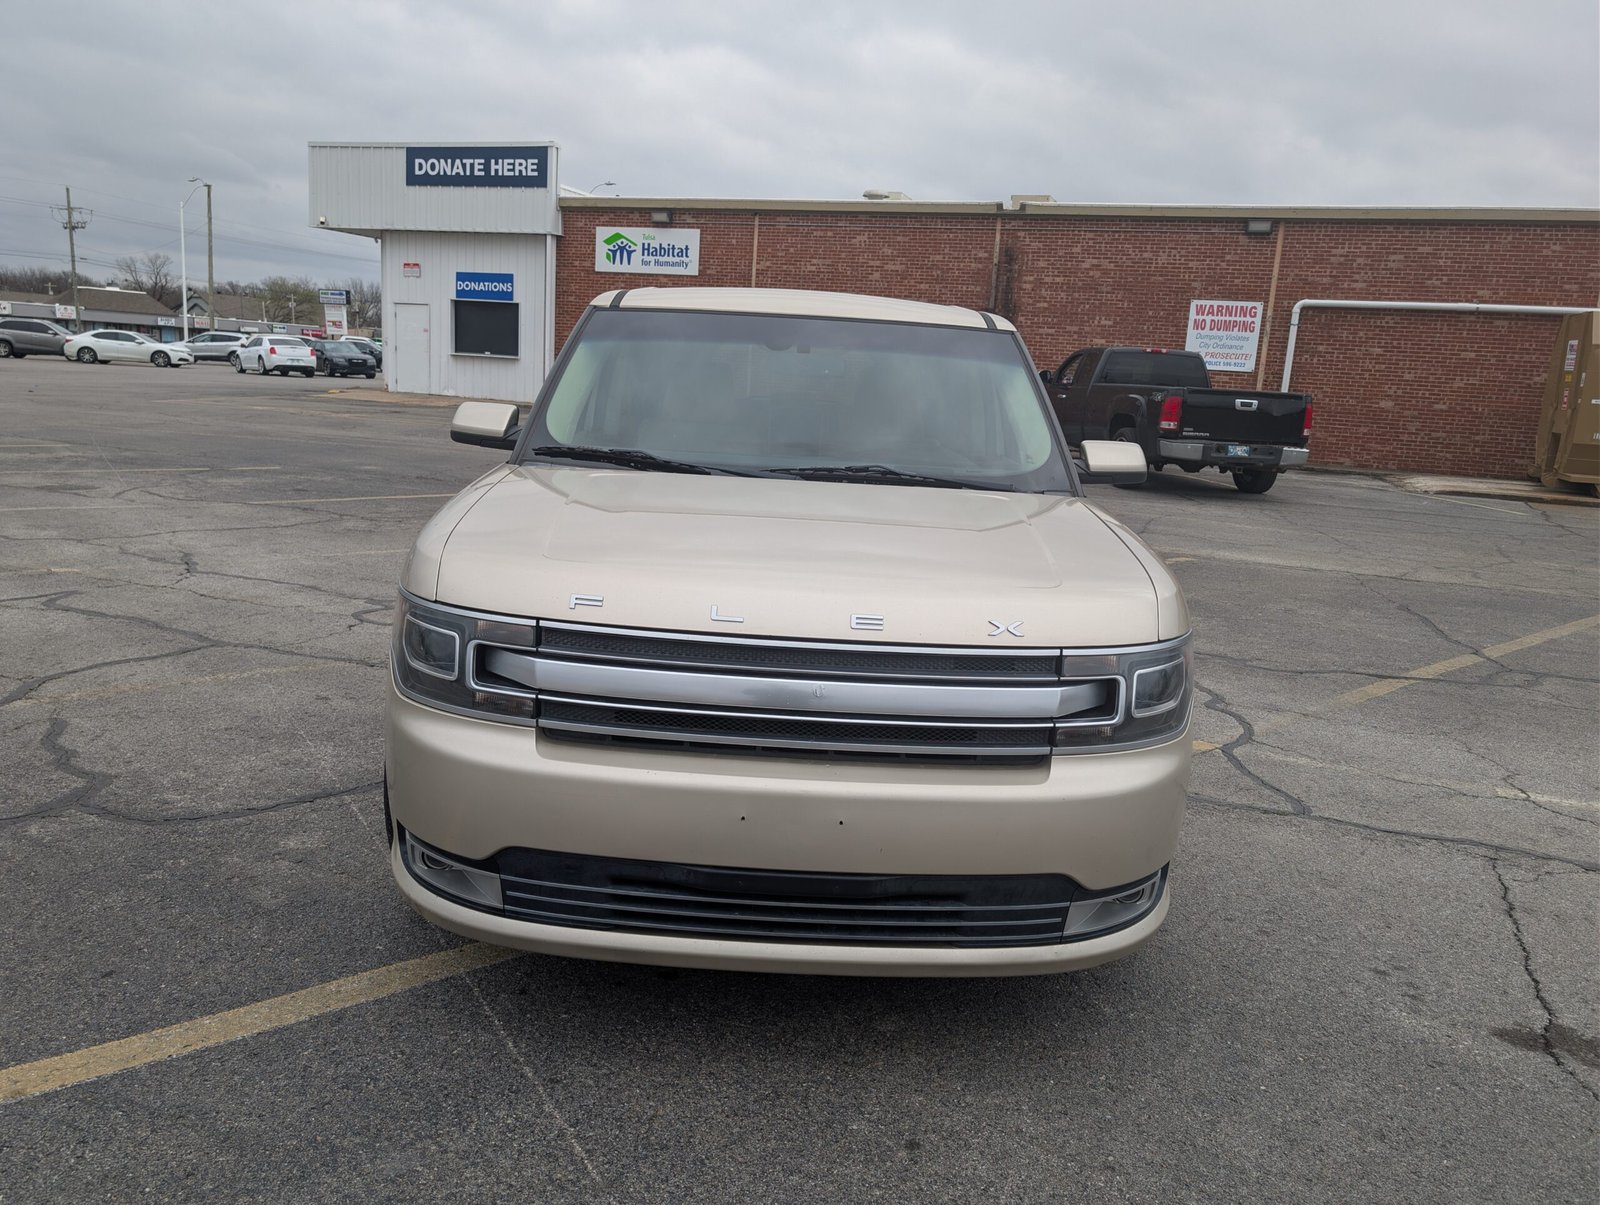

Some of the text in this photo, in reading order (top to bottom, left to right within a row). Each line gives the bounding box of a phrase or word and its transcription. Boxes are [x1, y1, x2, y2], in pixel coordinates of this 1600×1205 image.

[414, 158, 539, 177] DONATE HERE
[642, 233, 656, 241] Tulsa
[641, 242, 690, 258] Habitat
[641, 258, 690, 270] for Humanity
[456, 280, 513, 292] DONATIONS
[1195, 304, 1258, 318] WARNING
[1192, 318, 1256, 333] NO DUMPING
[1195, 332, 1250, 343] Dumping Violates
[1199, 341, 1245, 350] City Ordinance
[1203, 351, 1253, 361] PROSECUTE!
[569, 593, 1025, 637] FLEX
